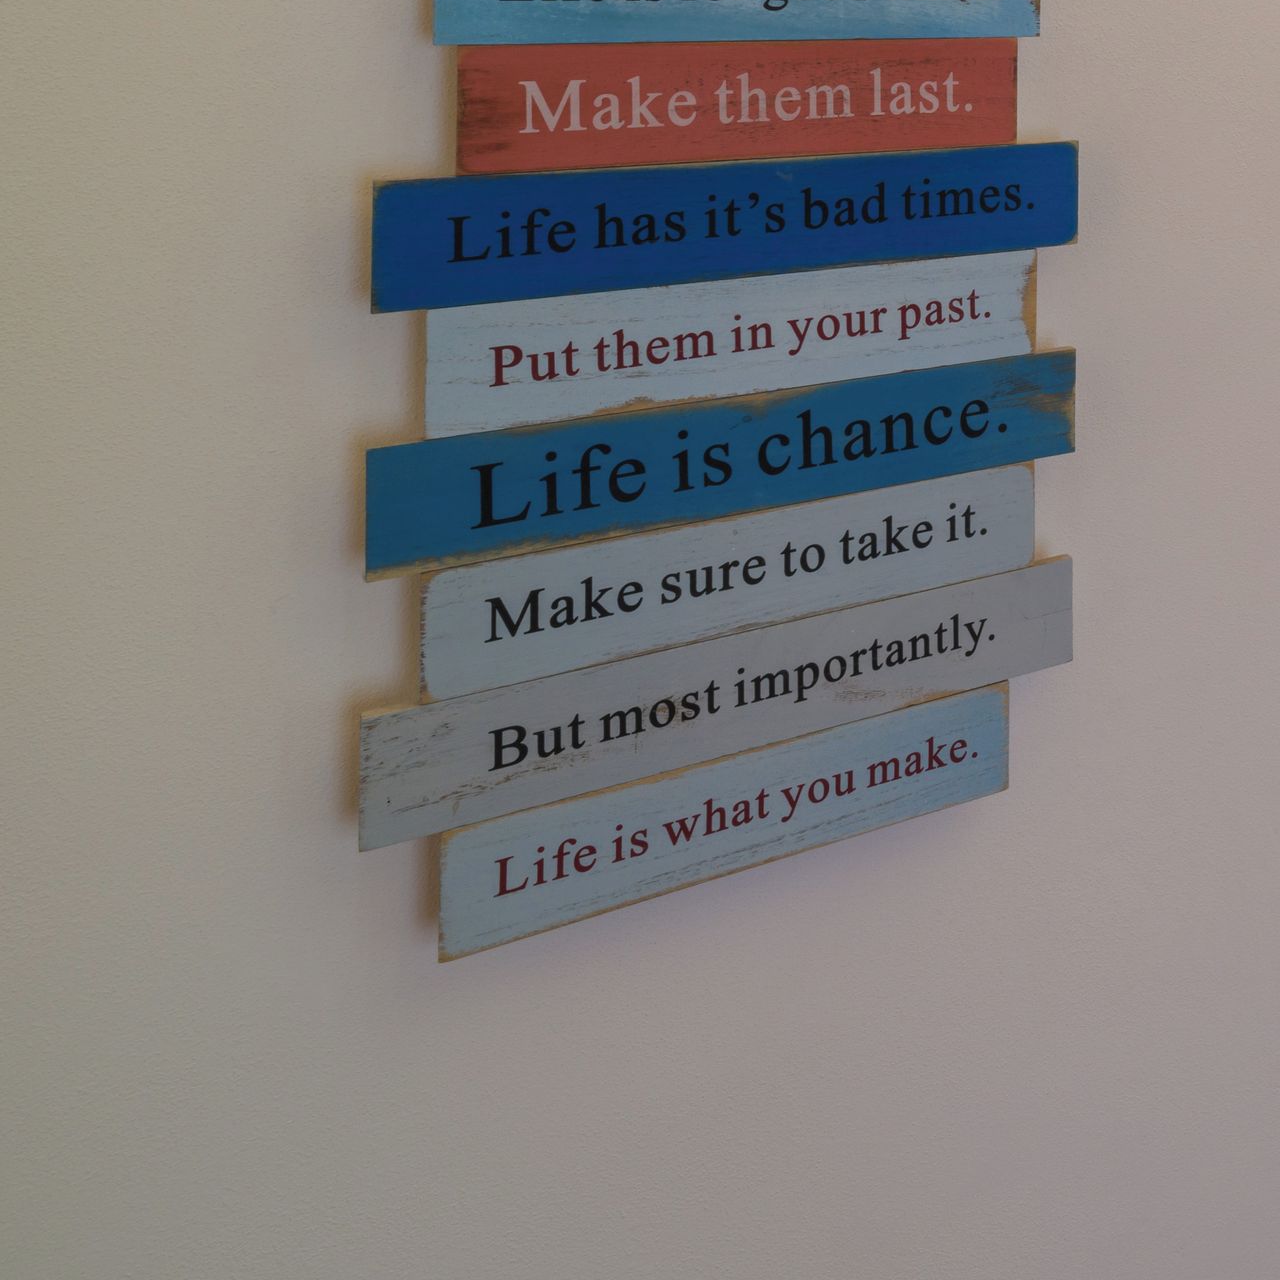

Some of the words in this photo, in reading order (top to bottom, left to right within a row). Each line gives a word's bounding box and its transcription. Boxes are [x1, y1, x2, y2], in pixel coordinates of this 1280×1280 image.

[519, 76, 698, 134] Make
[713, 72, 853, 125] them
[868, 68, 974, 117] last.
[447, 207, 578, 263] Life
[592, 204, 687, 249] has
[703, 192, 786, 239] it's
[799, 184, 888, 230] bad
[901, 178, 1036, 220] times.
[489, 341, 581, 388] Put
[595, 327, 716, 376] them
[731, 314, 775, 354] in
[787, 308, 888, 355] your
[898, 289, 992, 341] past.
[470, 444, 647, 530] Life
[672, 430, 734, 494] is
[757, 397, 1009, 477] chance.
[483, 574, 645, 644] Make
[659, 550, 767, 606] sure
[780, 539, 826, 577] to
[840, 516, 934, 564] take
[946, 504, 988, 542] it.
[487, 714, 587, 772] But
[600, 681, 721, 741] most
[733, 614, 997, 707] importantly.
[492, 836, 598, 899] Life
[611, 824, 651, 864] is
[662, 788, 771, 846] what
[780, 766, 858, 821] you
[867, 735, 979, 784] make.
